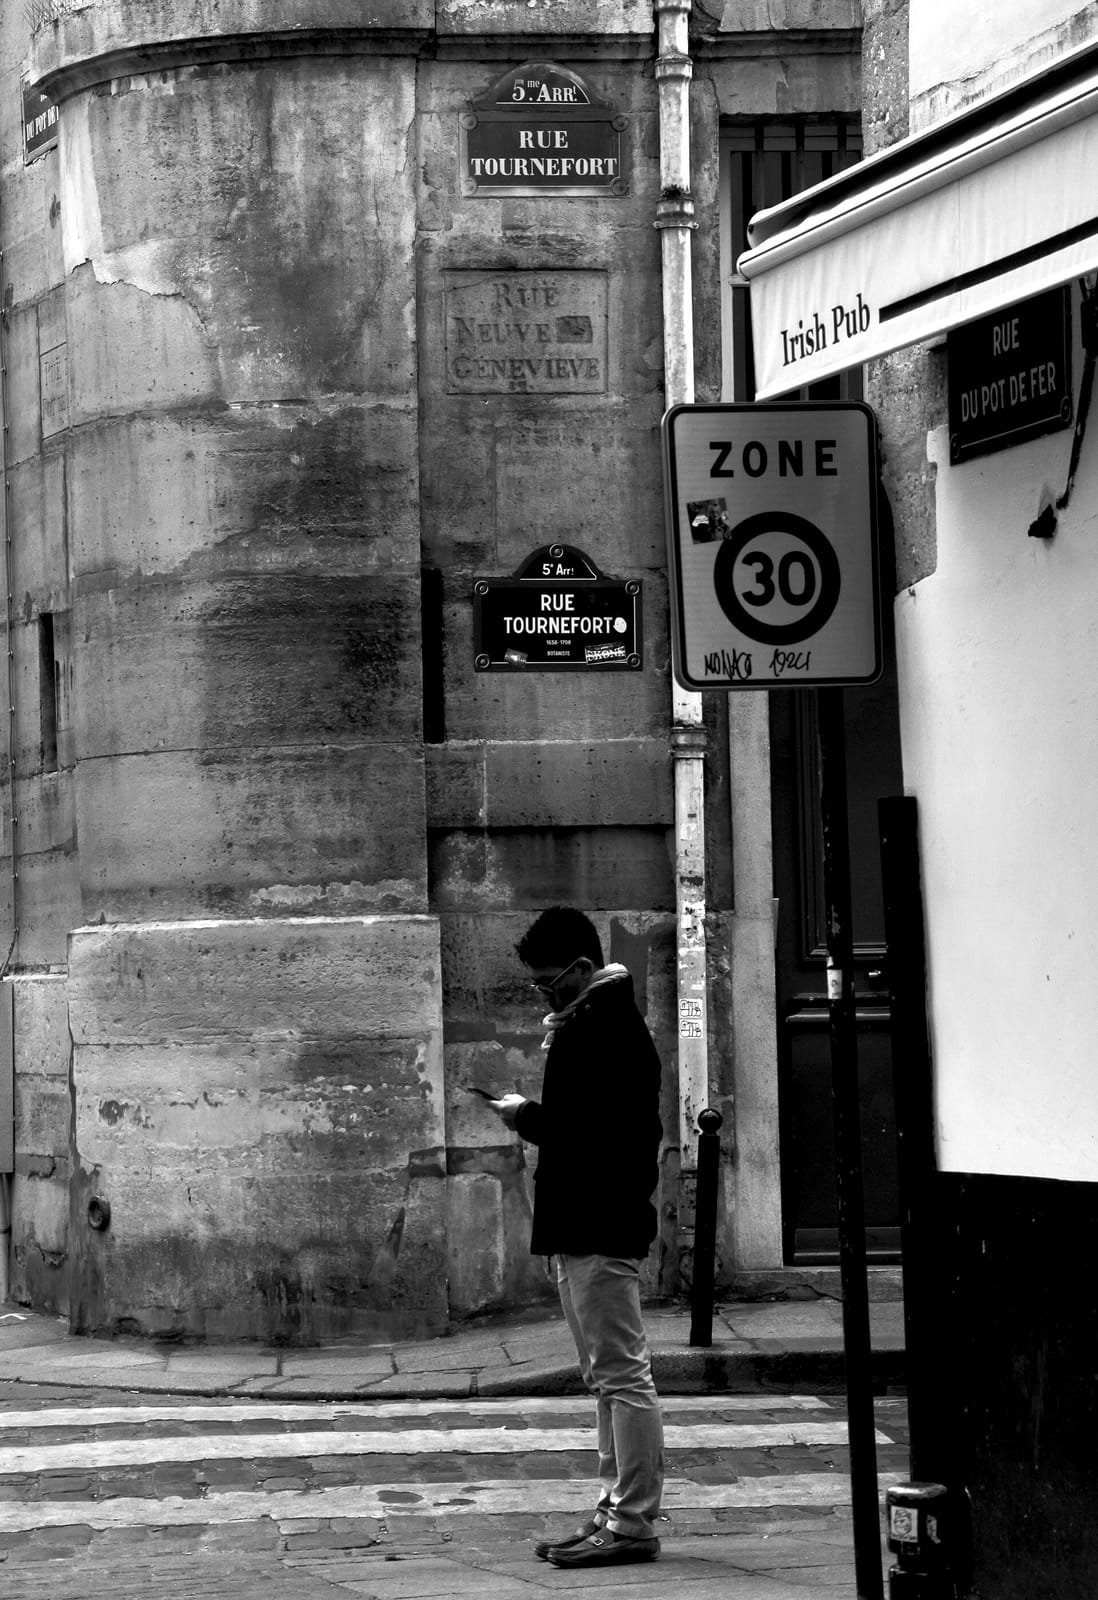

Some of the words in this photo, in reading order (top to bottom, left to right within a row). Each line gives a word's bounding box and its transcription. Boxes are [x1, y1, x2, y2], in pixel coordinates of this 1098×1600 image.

[519, 130, 569, 149] RUE
[471, 158, 617, 176] TOURNEFORT
[780, 313, 827, 367] Irish
[831, 293, 870, 345] Pub
[993, 318, 1020, 356] RUE
[961, 389, 978, 422] DU
[981, 379, 1005, 416] POT
[1009, 371, 1027, 406] DE
[1030, 361, 1056, 399] FER
[709, 440, 838, 478] ZONE
[741, 551, 816, 607] 30
[540, 594, 575, 611] RUE
[503, 617, 613, 634] TOURNEFORT
